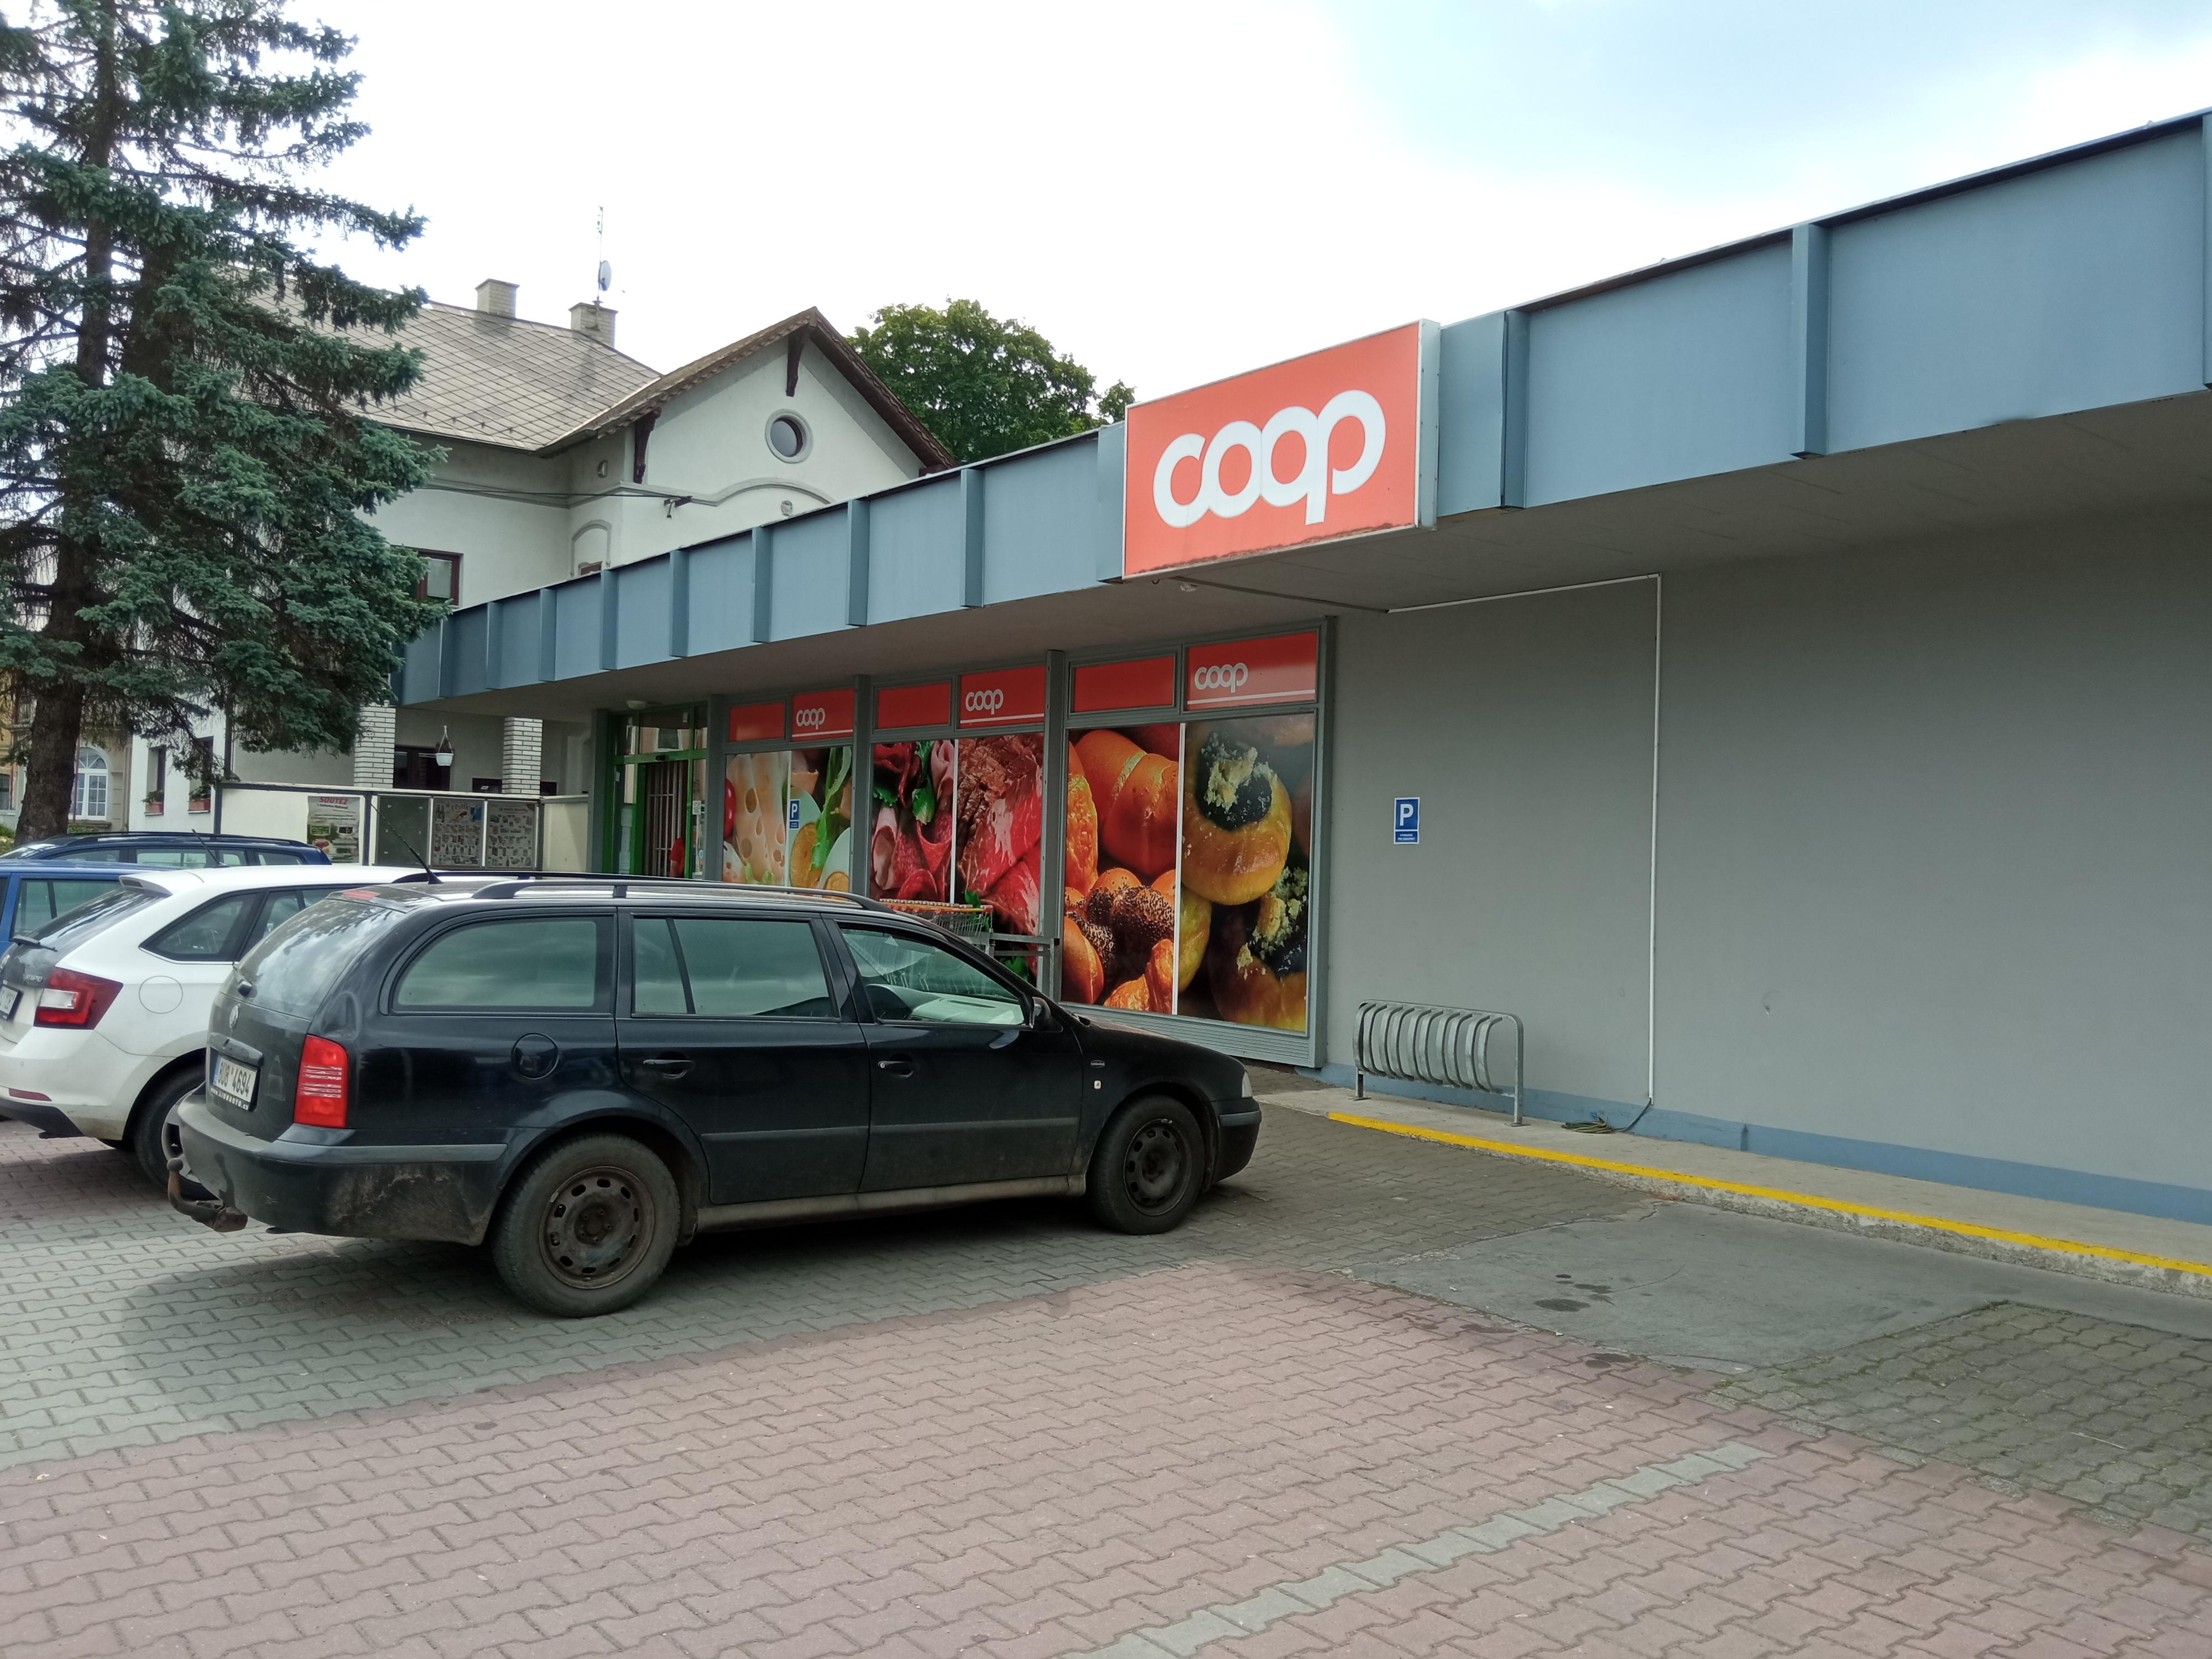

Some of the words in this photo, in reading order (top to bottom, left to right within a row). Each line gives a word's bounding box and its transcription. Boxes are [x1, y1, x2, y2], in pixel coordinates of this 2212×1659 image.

[1153, 390, 1386, 528] coop
[1194, 662, 1248, 693] coop
[966, 689, 1004, 714] coop
[796, 708, 825, 729] coop
[791, 803, 798, 818] P
[1400, 804, 1413, 826] P
[232, 1068, 252, 1098] 4694
